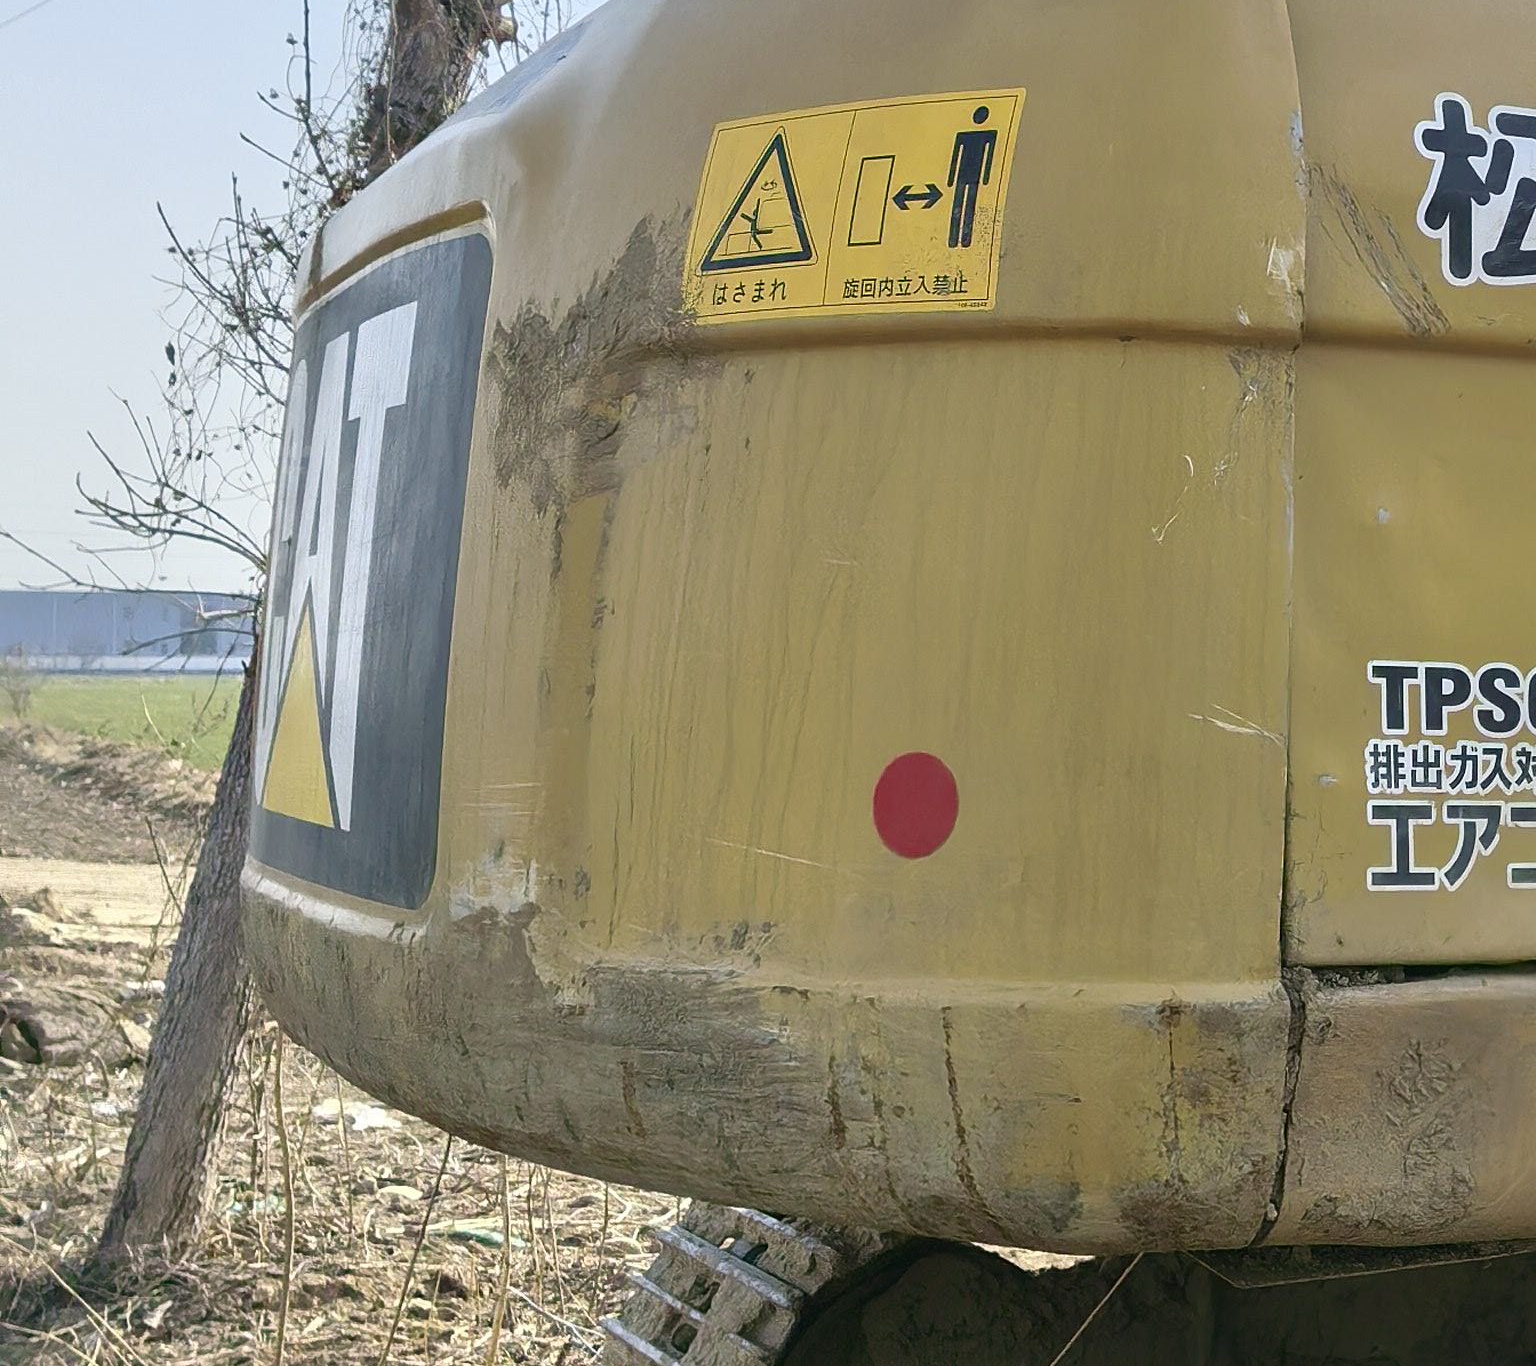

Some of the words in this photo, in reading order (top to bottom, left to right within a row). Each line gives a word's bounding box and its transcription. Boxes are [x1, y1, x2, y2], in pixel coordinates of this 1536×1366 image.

[711, 278, 788, 306] はさまれ
[842, 270, 969, 300] 旋回内立入禁止
